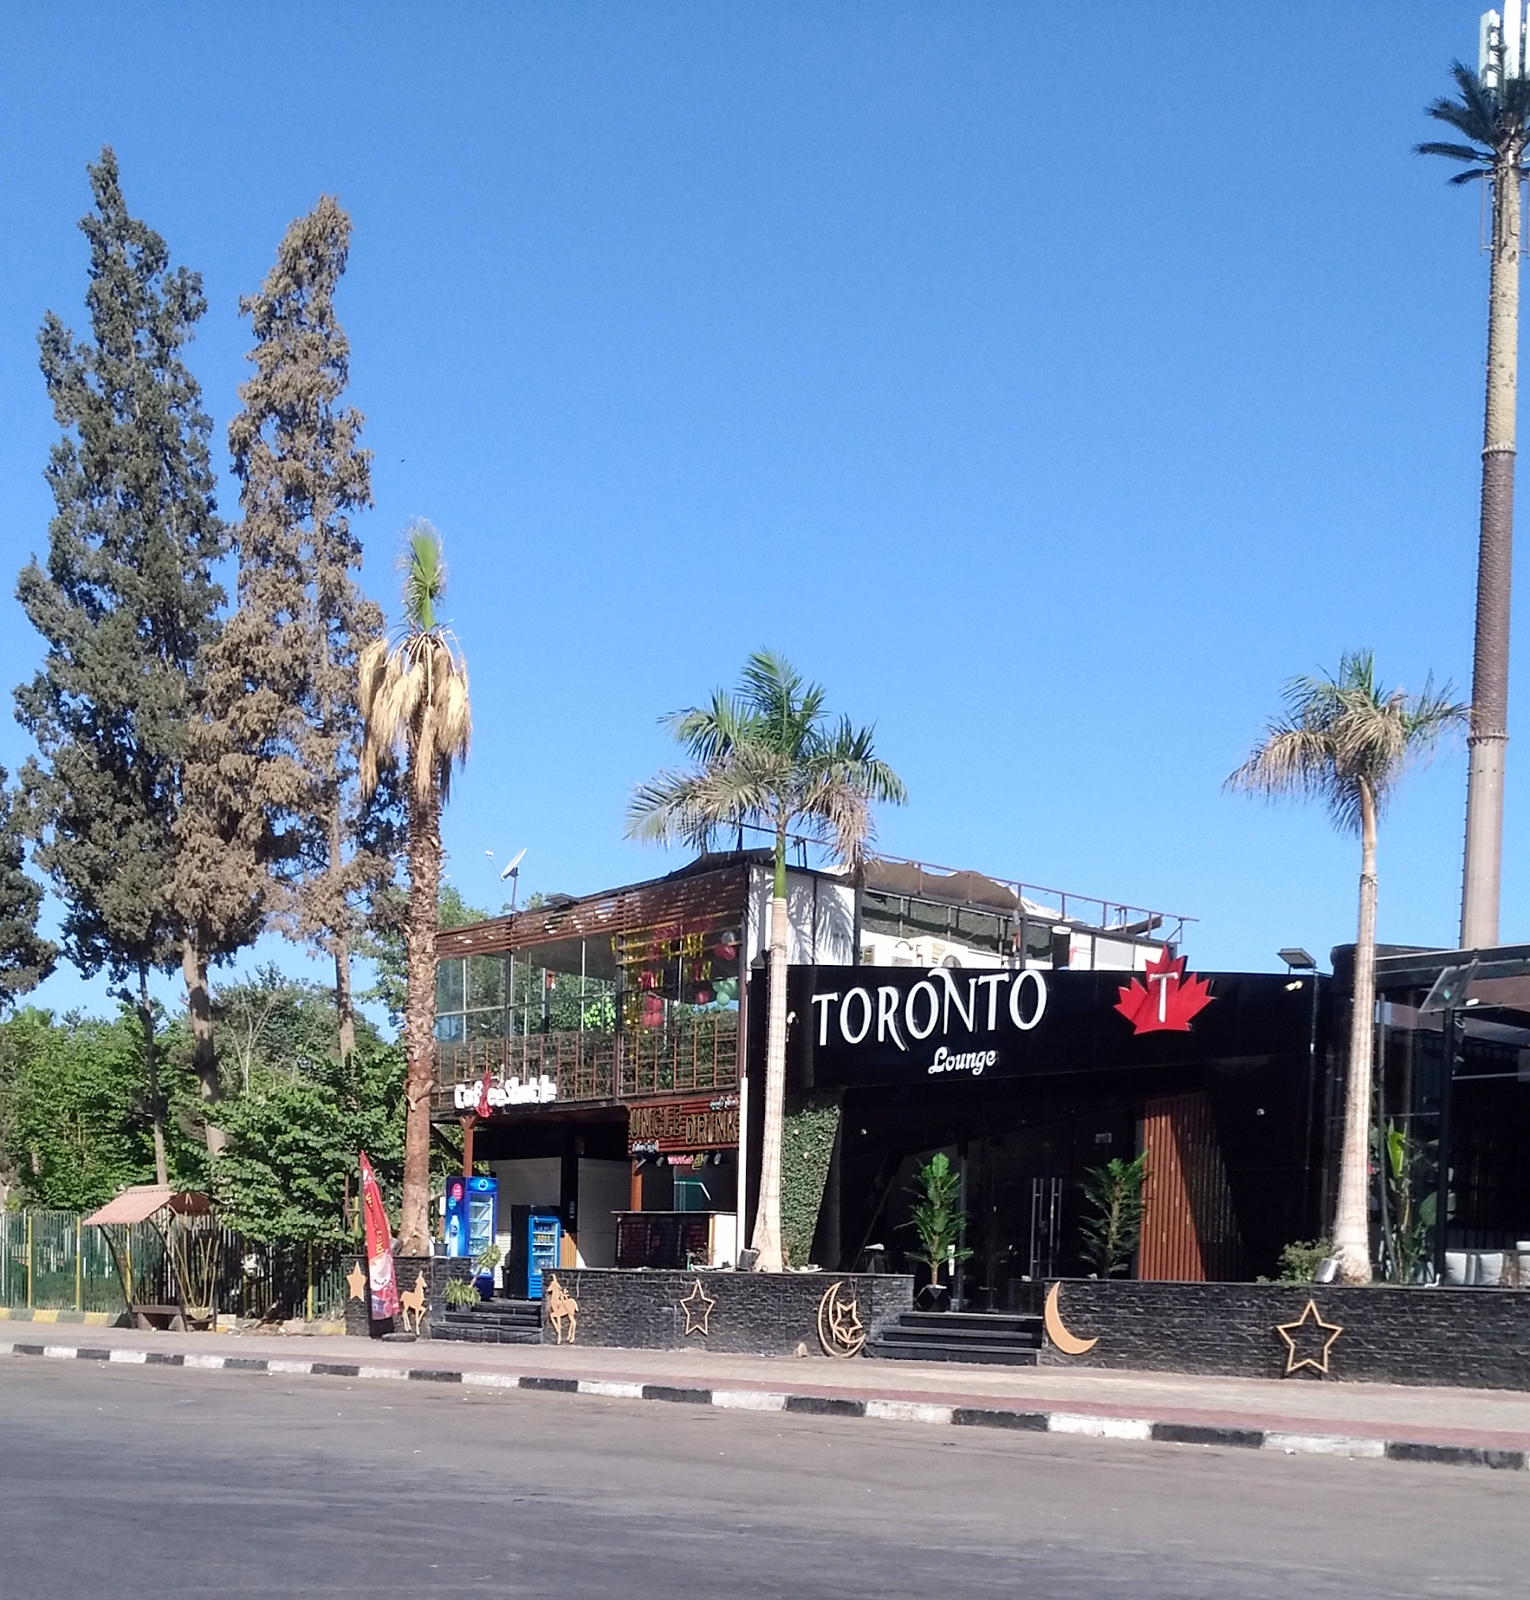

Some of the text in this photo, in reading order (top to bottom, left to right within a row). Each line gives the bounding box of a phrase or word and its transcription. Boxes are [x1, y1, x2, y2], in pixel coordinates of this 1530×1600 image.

[811, 967, 1048, 1051] TORONTO
[1148, 972, 1179, 1023] T
[927, 1046, 998, 1076] Lounge
[629, 1105, 682, 1139] UNCLE
[685, 1110, 738, 1145] DRINK
